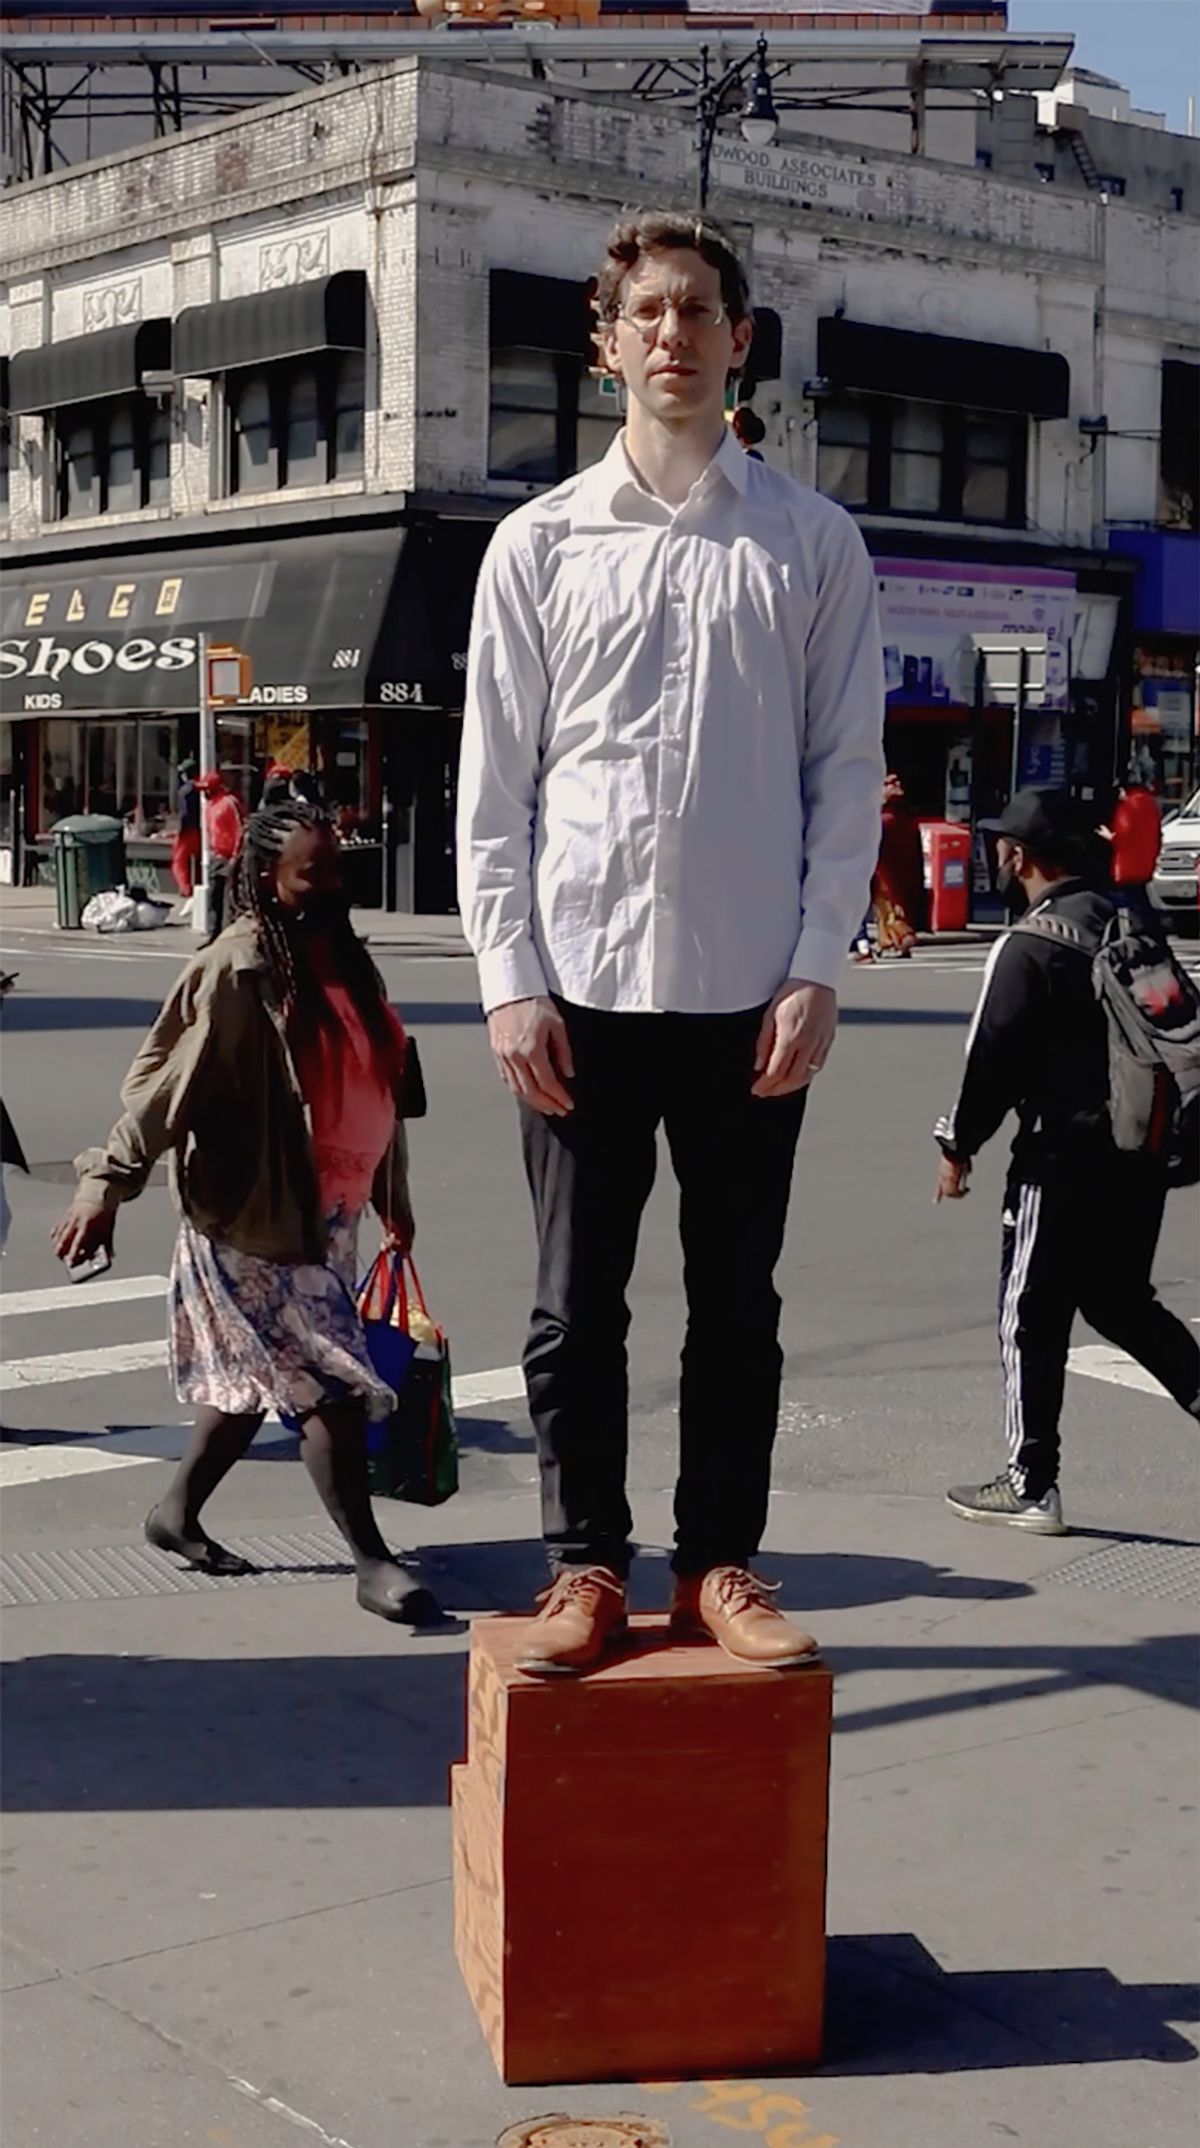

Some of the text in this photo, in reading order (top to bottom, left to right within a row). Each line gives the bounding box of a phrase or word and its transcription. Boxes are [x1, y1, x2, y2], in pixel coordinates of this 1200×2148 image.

[744, 169, 828, 198] BUILDINGS
[780, 158, 876, 188] ASSOCIATES
[0, 637, 197, 681] Shoes
[24, 692, 62, 709] KIDS
[380, 682, 423, 703] 884
